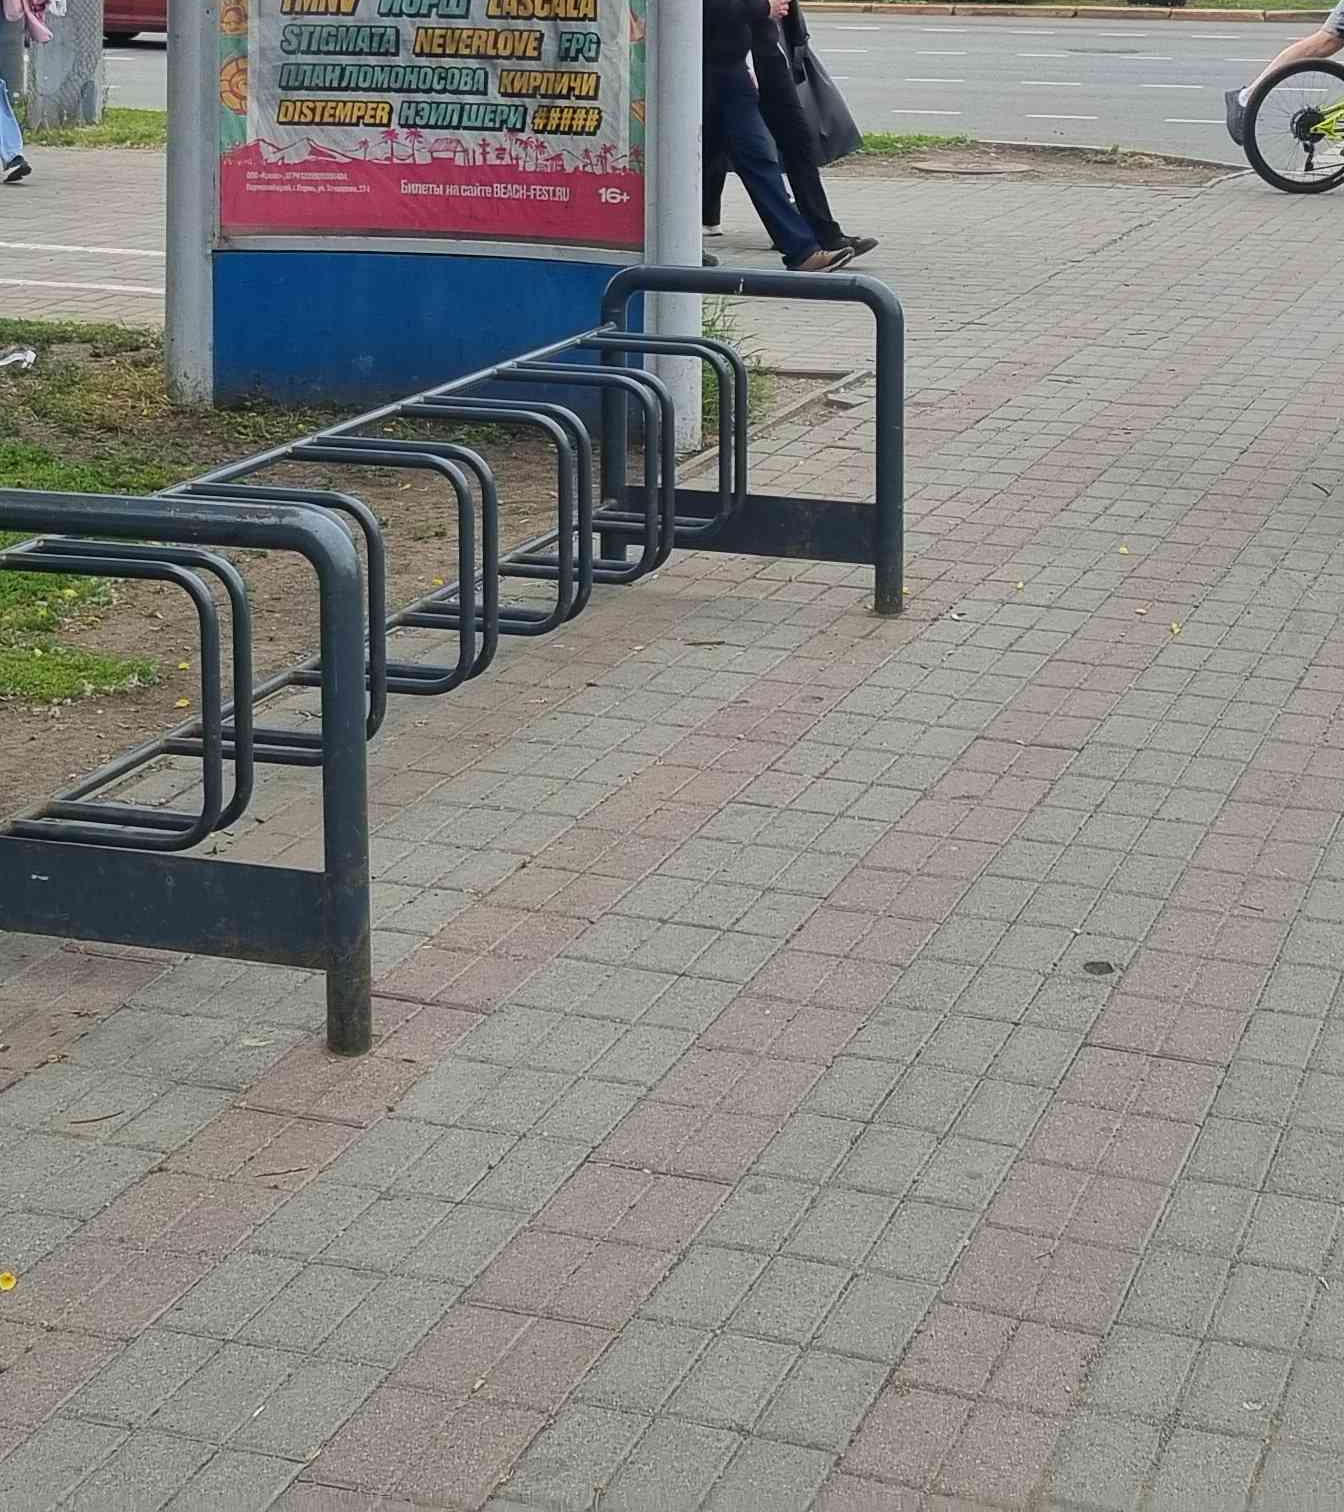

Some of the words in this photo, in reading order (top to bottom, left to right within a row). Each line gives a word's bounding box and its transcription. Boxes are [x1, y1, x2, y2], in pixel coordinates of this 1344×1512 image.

[280, 24, 400, 57] STIGMATA
[413, 27, 544, 61] NEVERLOVE
[557, 31, 601, 63] FPG
[279, 63, 344, 91] ПЛАН
[342, 64, 489, 96] ЛОМОНОСОВА
[498, 70, 600, 100] КИРПИЧИ
[277, 99, 393, 126] DISTEMPER
[400, 179, 444, 197] Билеты
[445, 184, 460, 196] на
[460, 182, 492, 198] сайте
[492, 184, 570, 202] BEACH-FEST.RU
[597, 187, 631, 203] 16+
